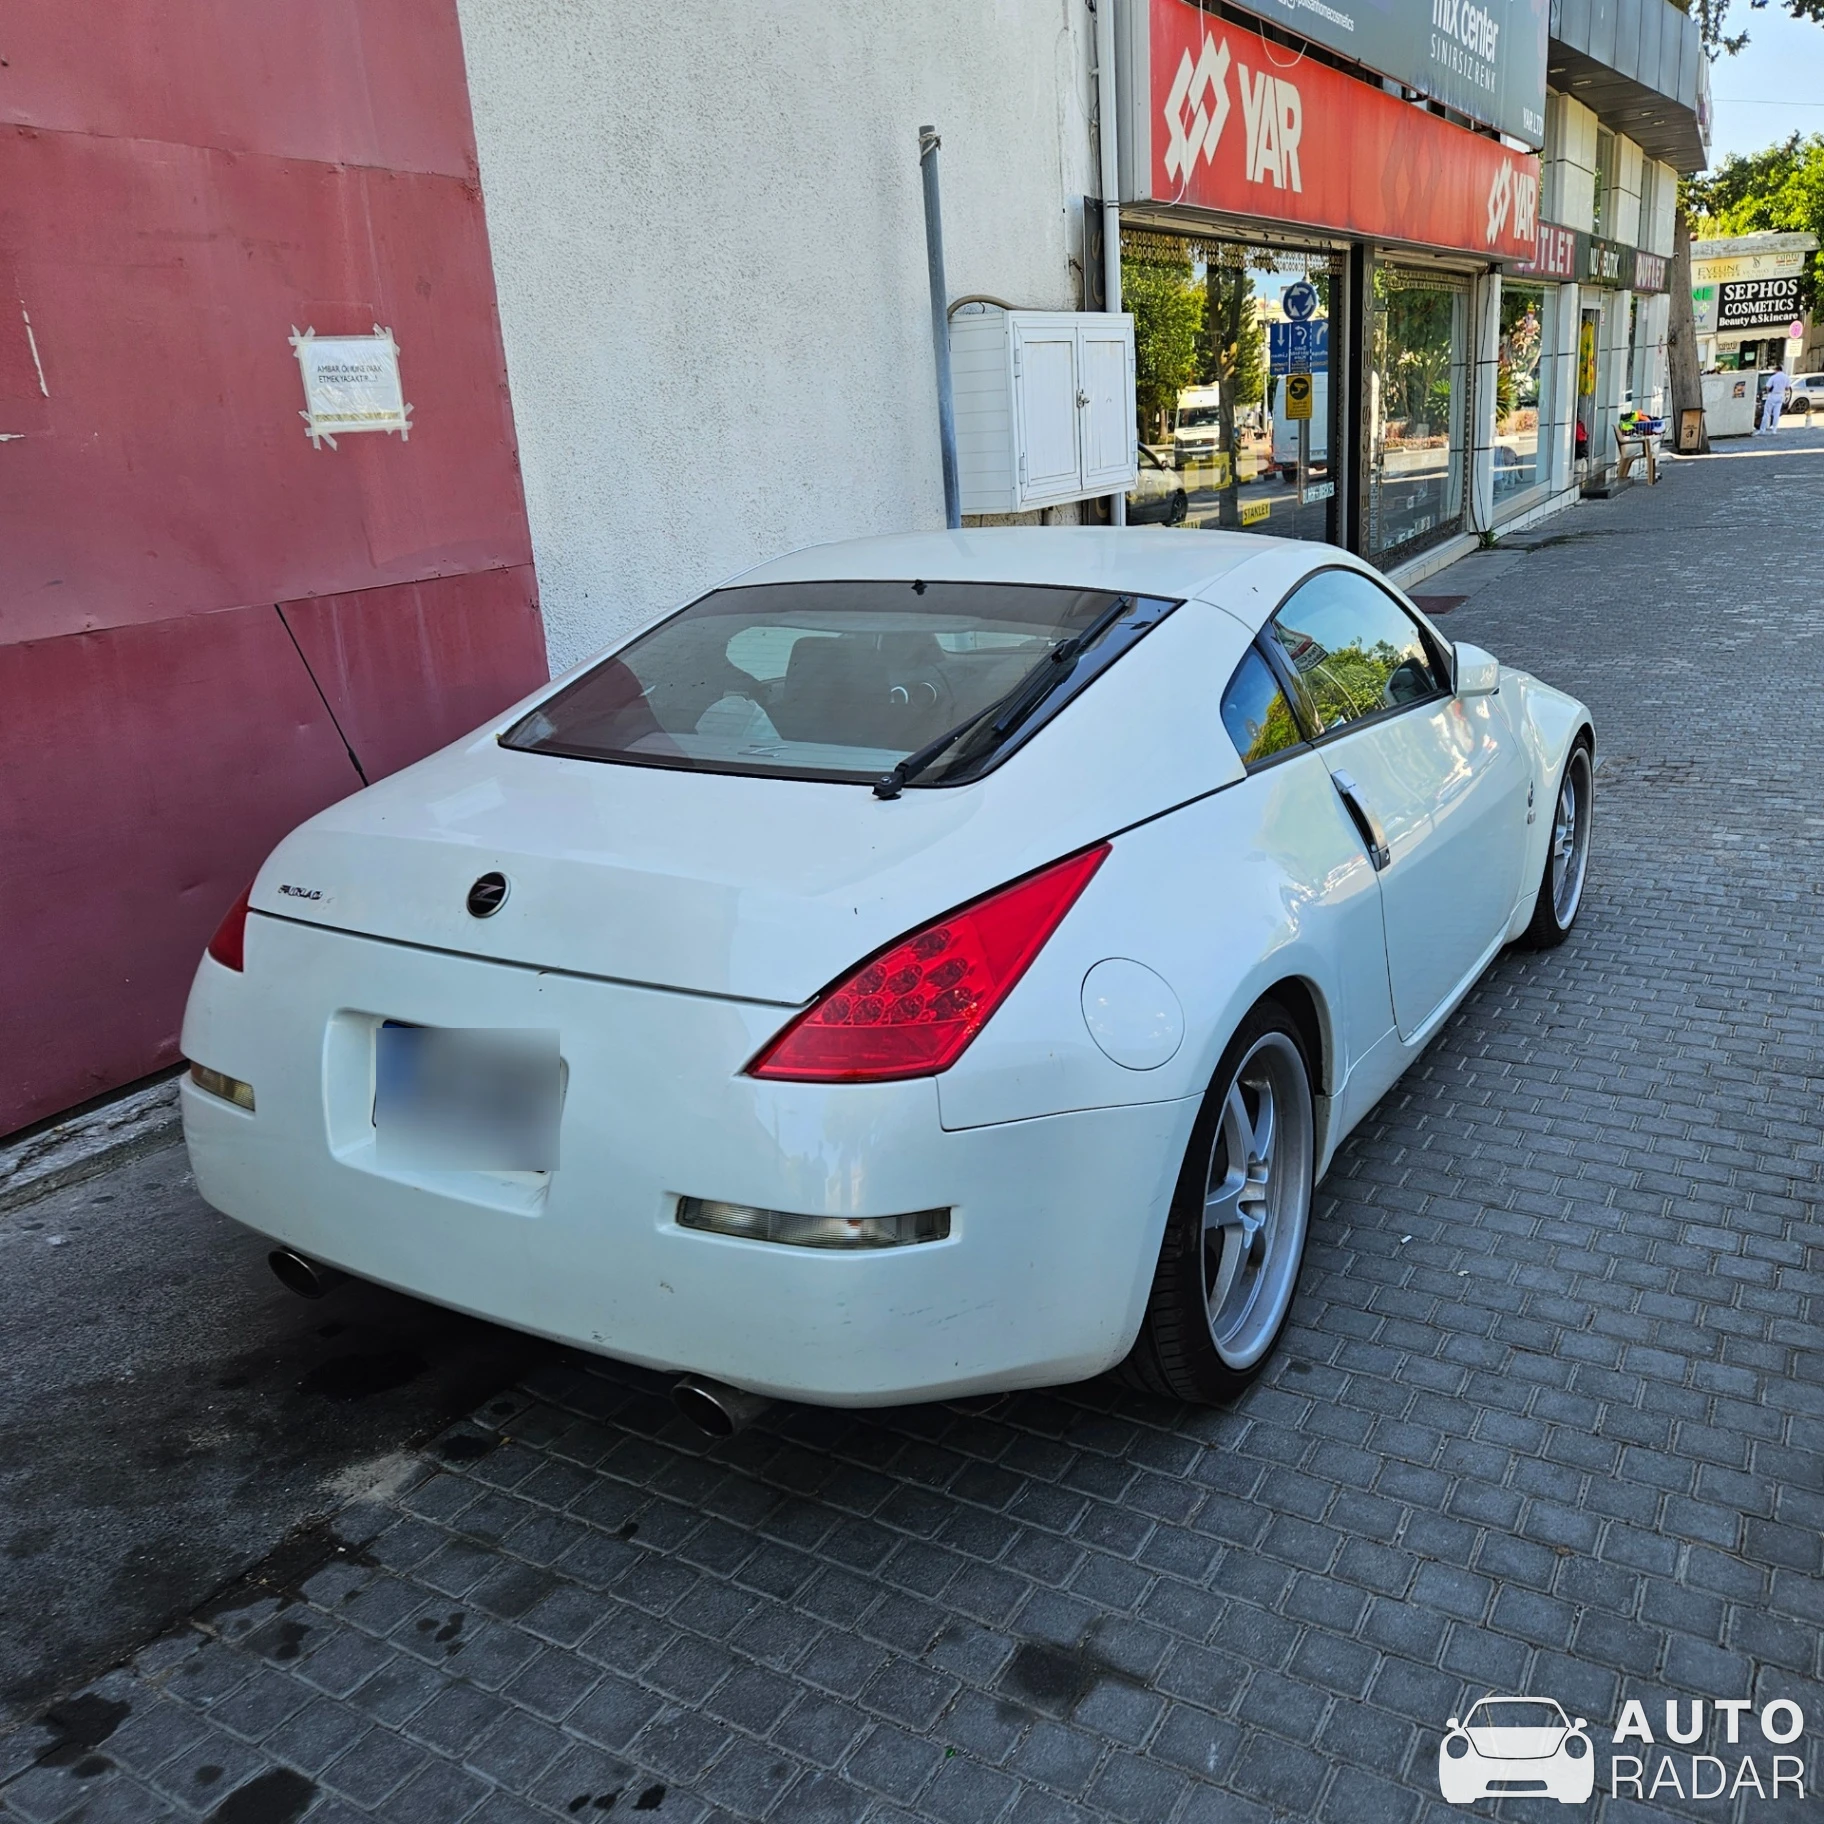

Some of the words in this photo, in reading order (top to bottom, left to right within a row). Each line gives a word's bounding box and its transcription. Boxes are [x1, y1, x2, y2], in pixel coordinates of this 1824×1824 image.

[1461, 2, 1499, 63] center
[1430, 33, 1473, 80] SINIRSIZ
[1474, 61, 1496, 93] RENK
[1238, 63, 1302, 193] YAR
[1513, 170, 1536, 242] YAR
[1518, 225, 1573, 275] UTLET
[1636, 253, 1666, 290] OUTLET
[1698, 264, 1740, 276] EVELINE
[1724, 279, 1798, 301] SEPHOS
[1725, 298, 1795, 316] COSMETICS
[317, 365, 340, 373] AMBAR
[319, 375, 340, 383] ETMEK
[1243, 503, 1269, 521] STANLEY
